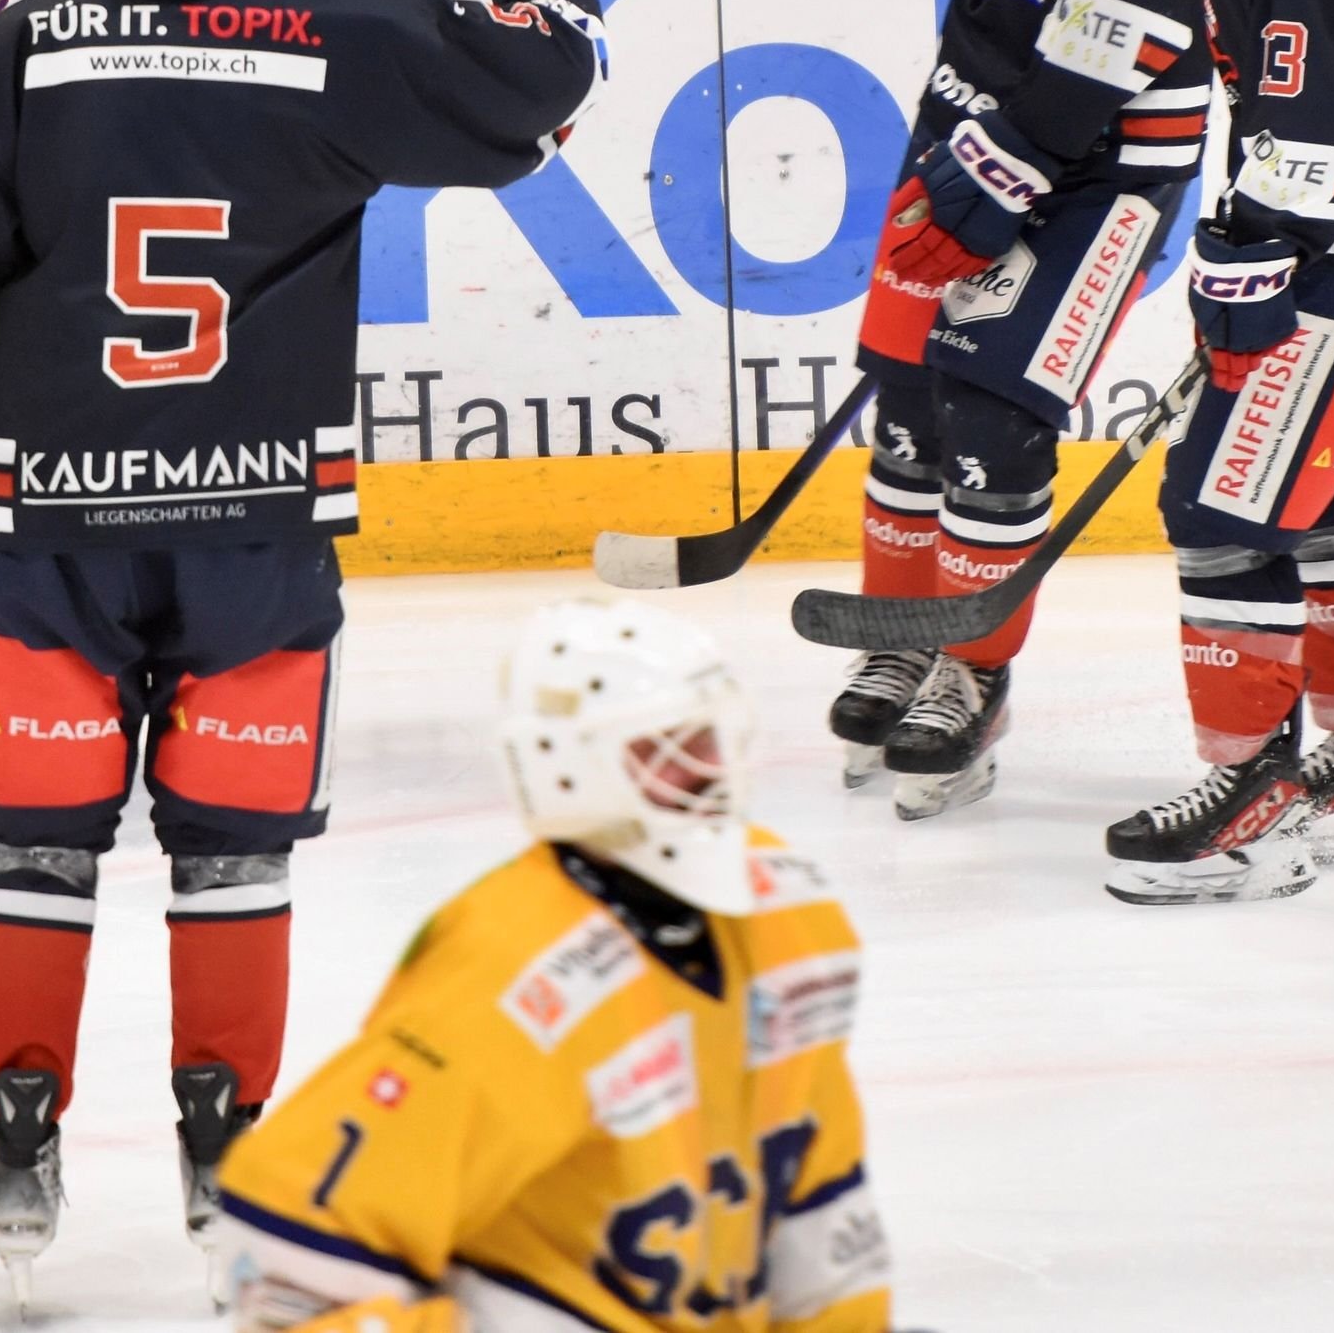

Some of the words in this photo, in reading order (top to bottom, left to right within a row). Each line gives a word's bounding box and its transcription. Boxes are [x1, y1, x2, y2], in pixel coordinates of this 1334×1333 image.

[27, 0, 109, 46] FÜR
[120, 3, 169, 37] IT.
[180, 4, 324, 47] TOPIX.
[90, 52, 257, 76] www.topix.ch
[102, 197, 231, 389] 5
[1042, 208, 1140, 378] RAIFFEISEN
[356, 368, 693, 464] Haus
[1214, 328, 1315, 498] RAIFFEISEN
[1250, 437, 1283, 504] Raiffeisenbank
[1279, 376, 1308, 434] Appenzeller
[1305, 333, 1331, 380] Hinterland
[20, 439, 308, 494] KAUFMANN
[84, 506, 222, 526] LIEGENSCHAFTEN
[226, 503, 247, 518] AG
[9, 716, 122, 740] FLAGA
[196, 716, 309, 746] FLAGA
[312, 1118, 366, 1207] 1
